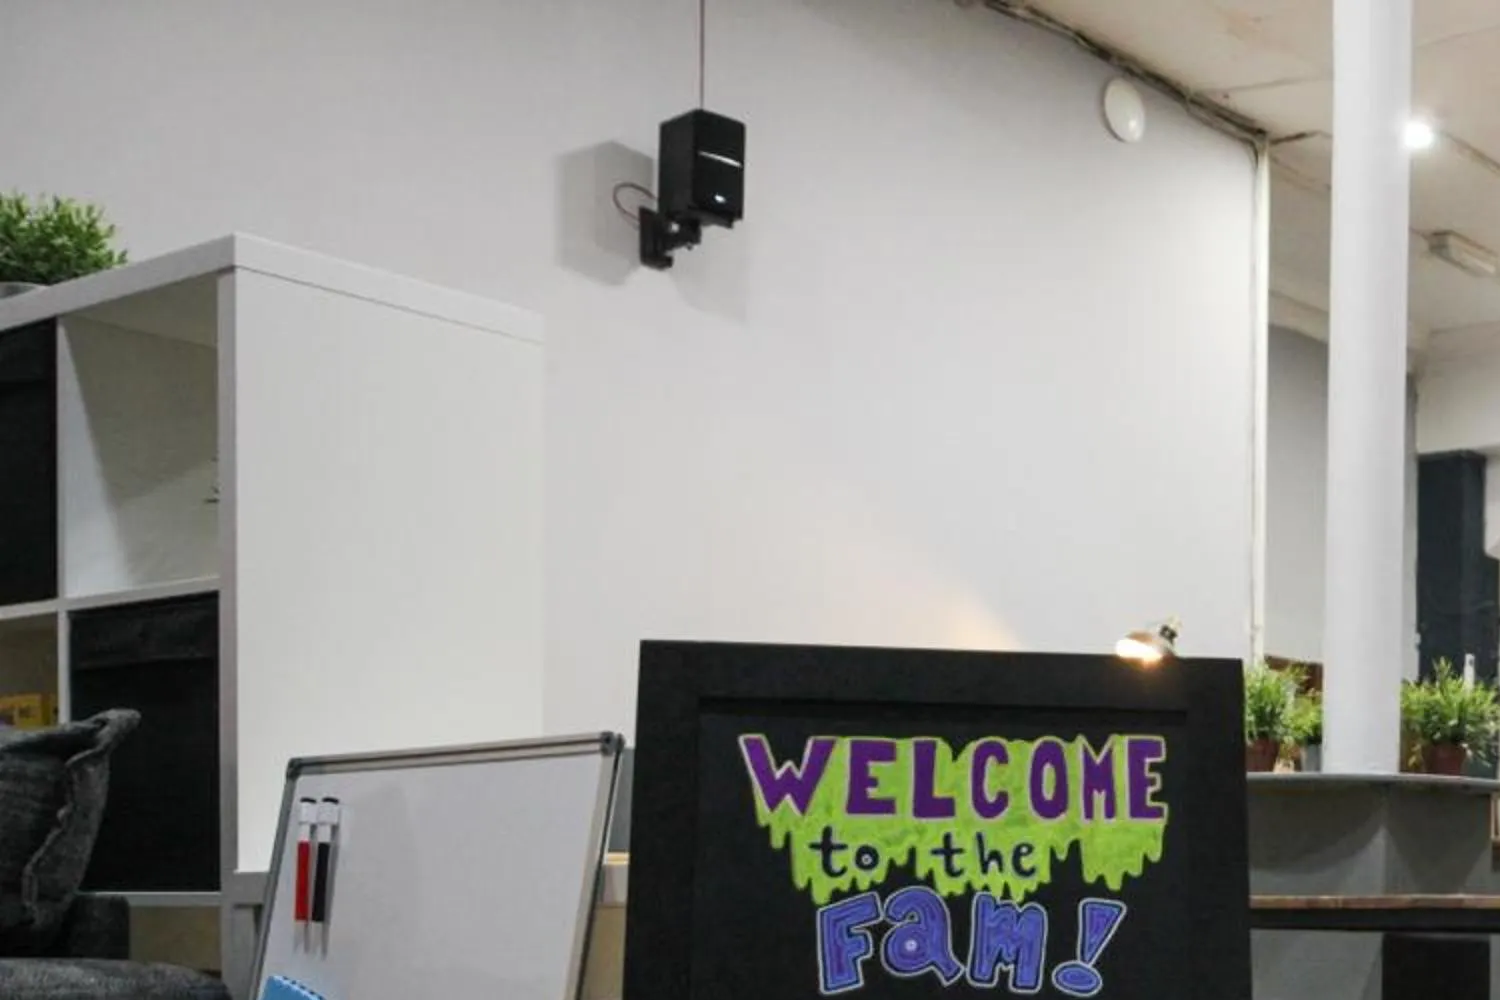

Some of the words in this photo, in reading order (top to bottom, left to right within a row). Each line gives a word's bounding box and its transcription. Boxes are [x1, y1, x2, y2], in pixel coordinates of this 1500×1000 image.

[739, 733, 1169, 825] WELCOME
[808, 825, 881, 879] to
[930, 831, 1038, 879] the
